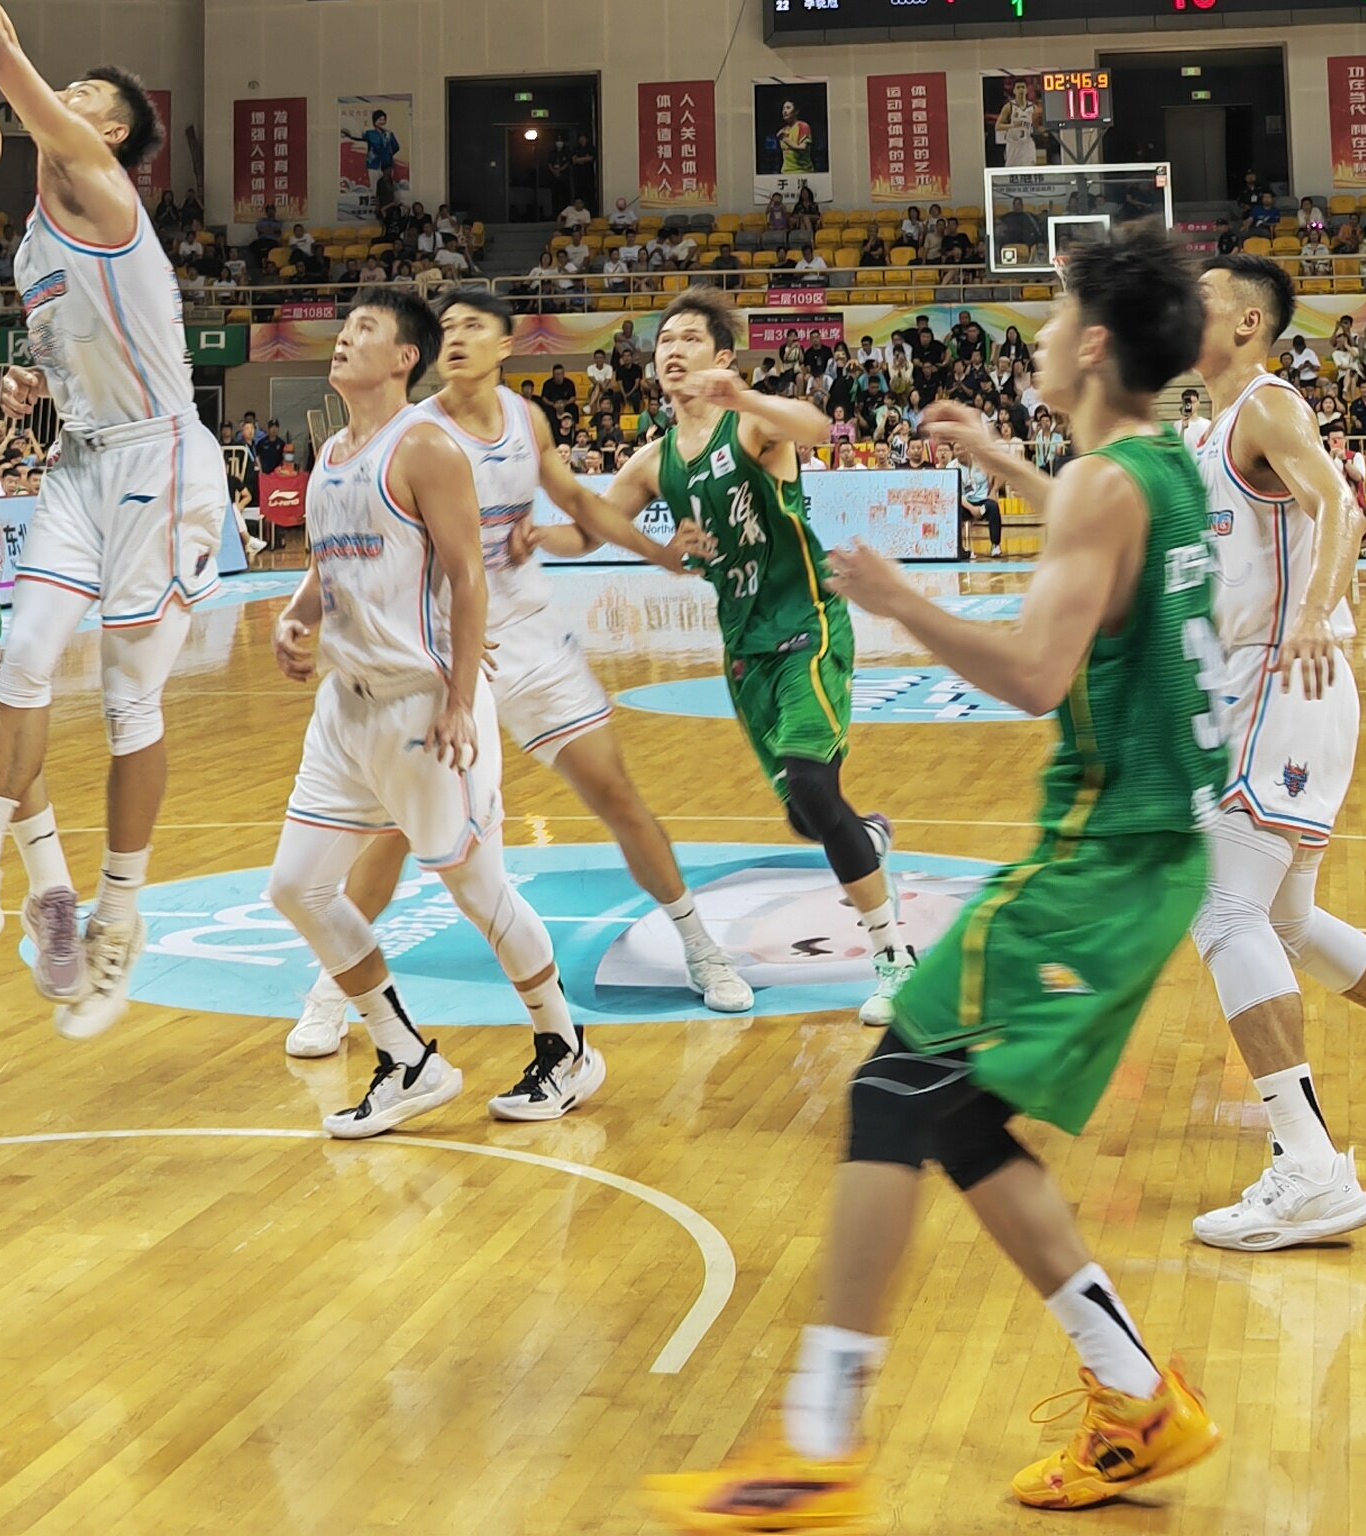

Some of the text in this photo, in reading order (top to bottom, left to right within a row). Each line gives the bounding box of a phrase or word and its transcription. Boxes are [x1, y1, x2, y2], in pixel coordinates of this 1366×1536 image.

[776, 0, 790, 11] 22
[1043, 73, 1109, 91] 02:46.9
[1348, 66, 1366, 117] 功在当代
[1067, 88, 1099, 120] 10
[656, 94, 674, 192] 体育造福人人
[679, 93, 697, 192] 人人关心体育
[769, 292, 824, 305] 二层109区
